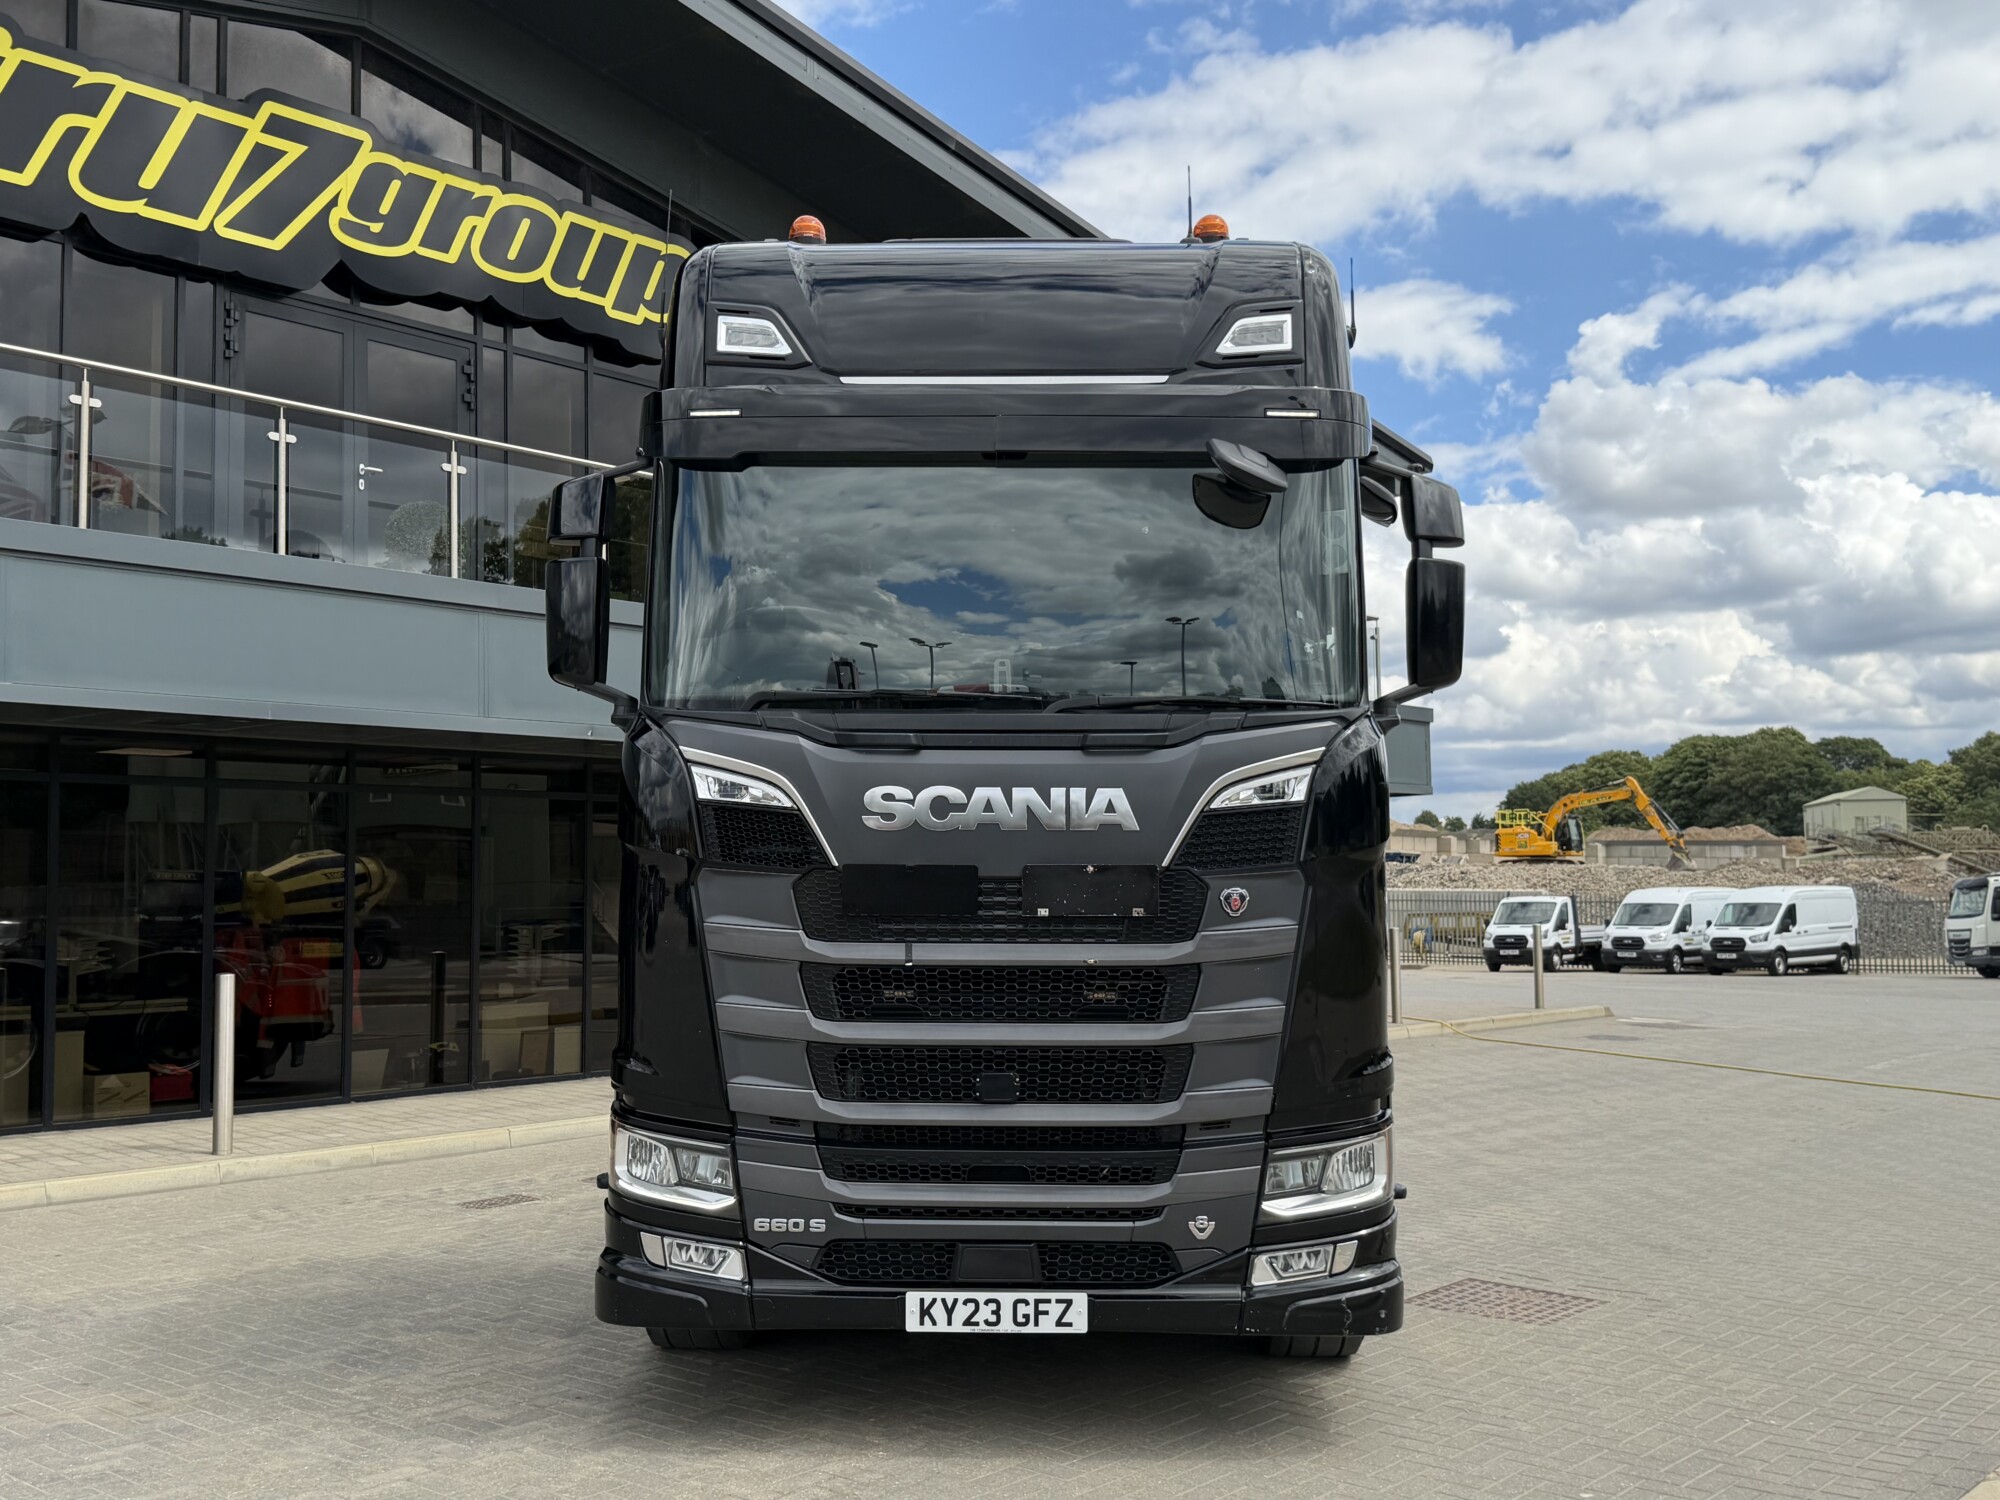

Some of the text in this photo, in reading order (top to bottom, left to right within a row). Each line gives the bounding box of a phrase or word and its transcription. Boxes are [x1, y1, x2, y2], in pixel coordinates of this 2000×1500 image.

[0, 27, 692, 325] ru7group
[861, 785, 1140, 831] SCANIA
[753, 1218, 826, 1233] 660 S
[919, 1297, 1073, 1328] KY23 GFZ
